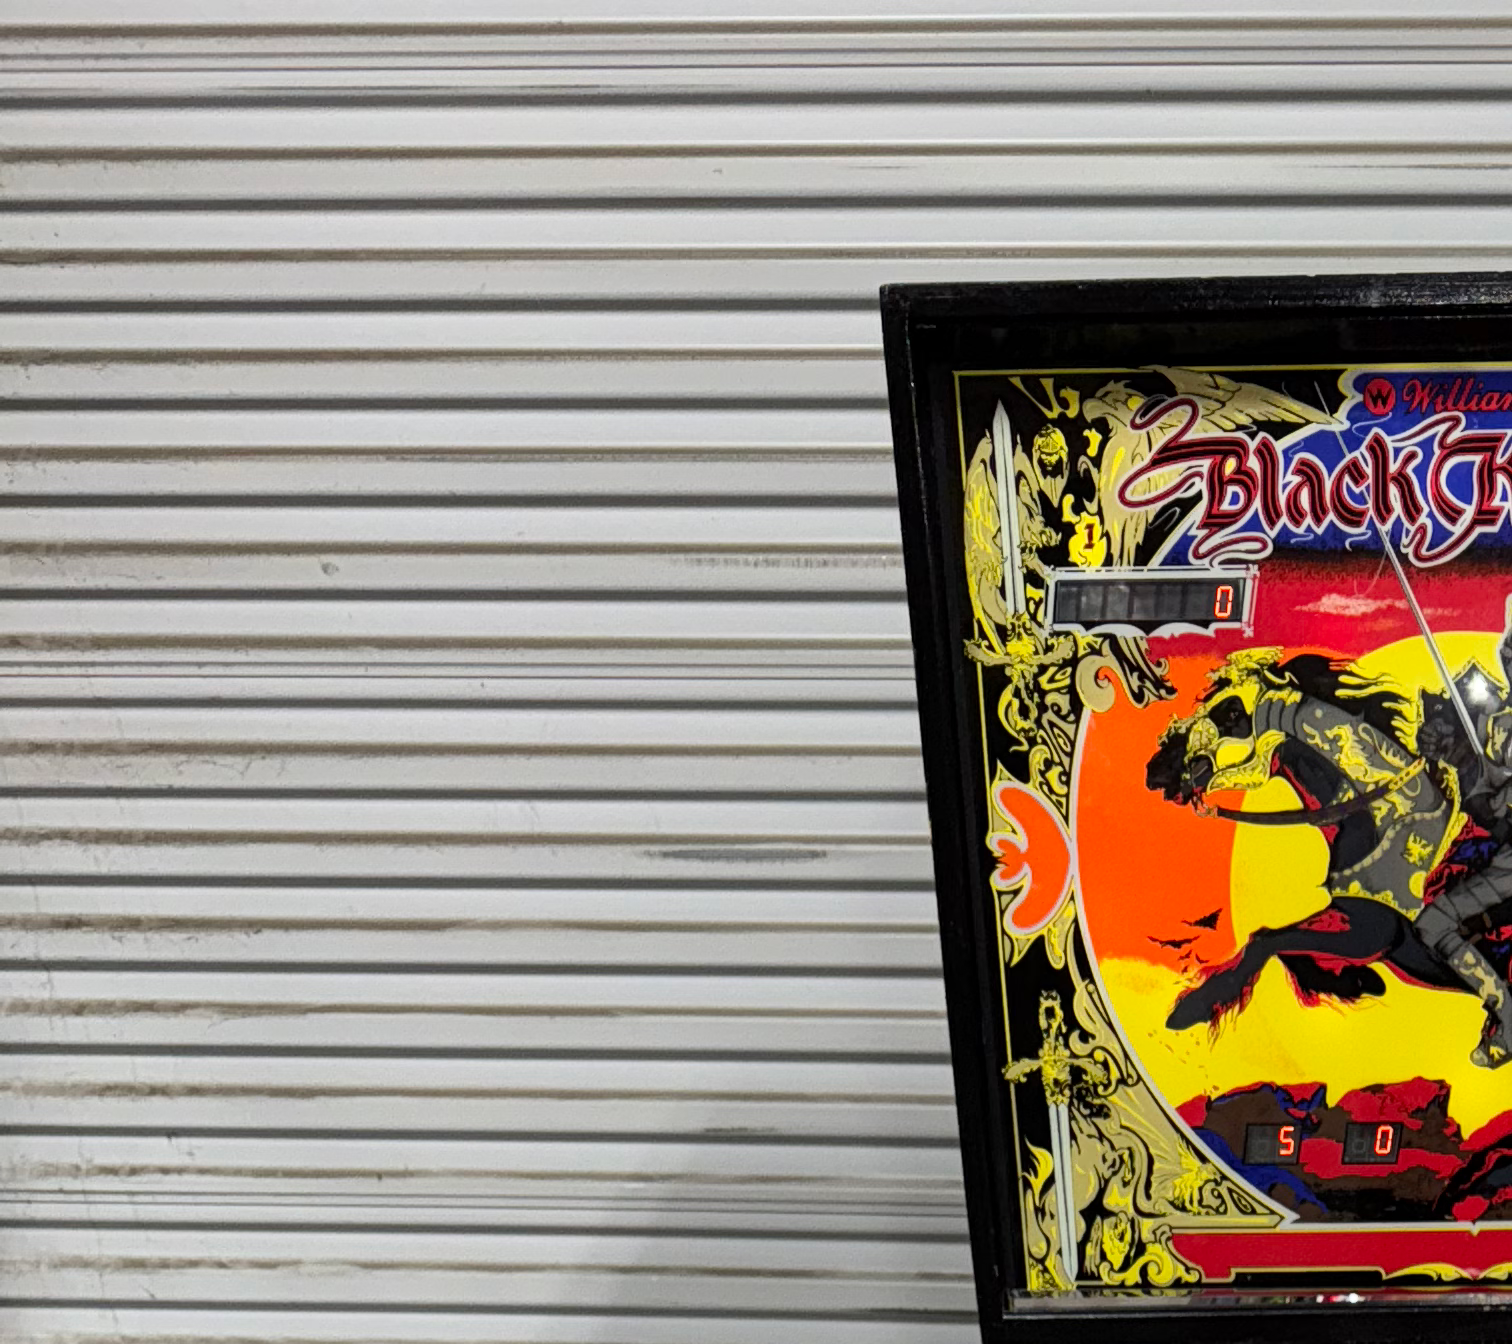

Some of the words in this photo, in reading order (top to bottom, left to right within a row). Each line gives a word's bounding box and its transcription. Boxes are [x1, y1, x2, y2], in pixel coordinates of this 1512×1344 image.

[1119, 399, 1421, 562] Black
[1083, 523, 1096, 550] 1
[1213, 584, 1234, 618] 0
[1278, 1124, 1296, 1156] 5
[1374, 1124, 1395, 1156] 0
